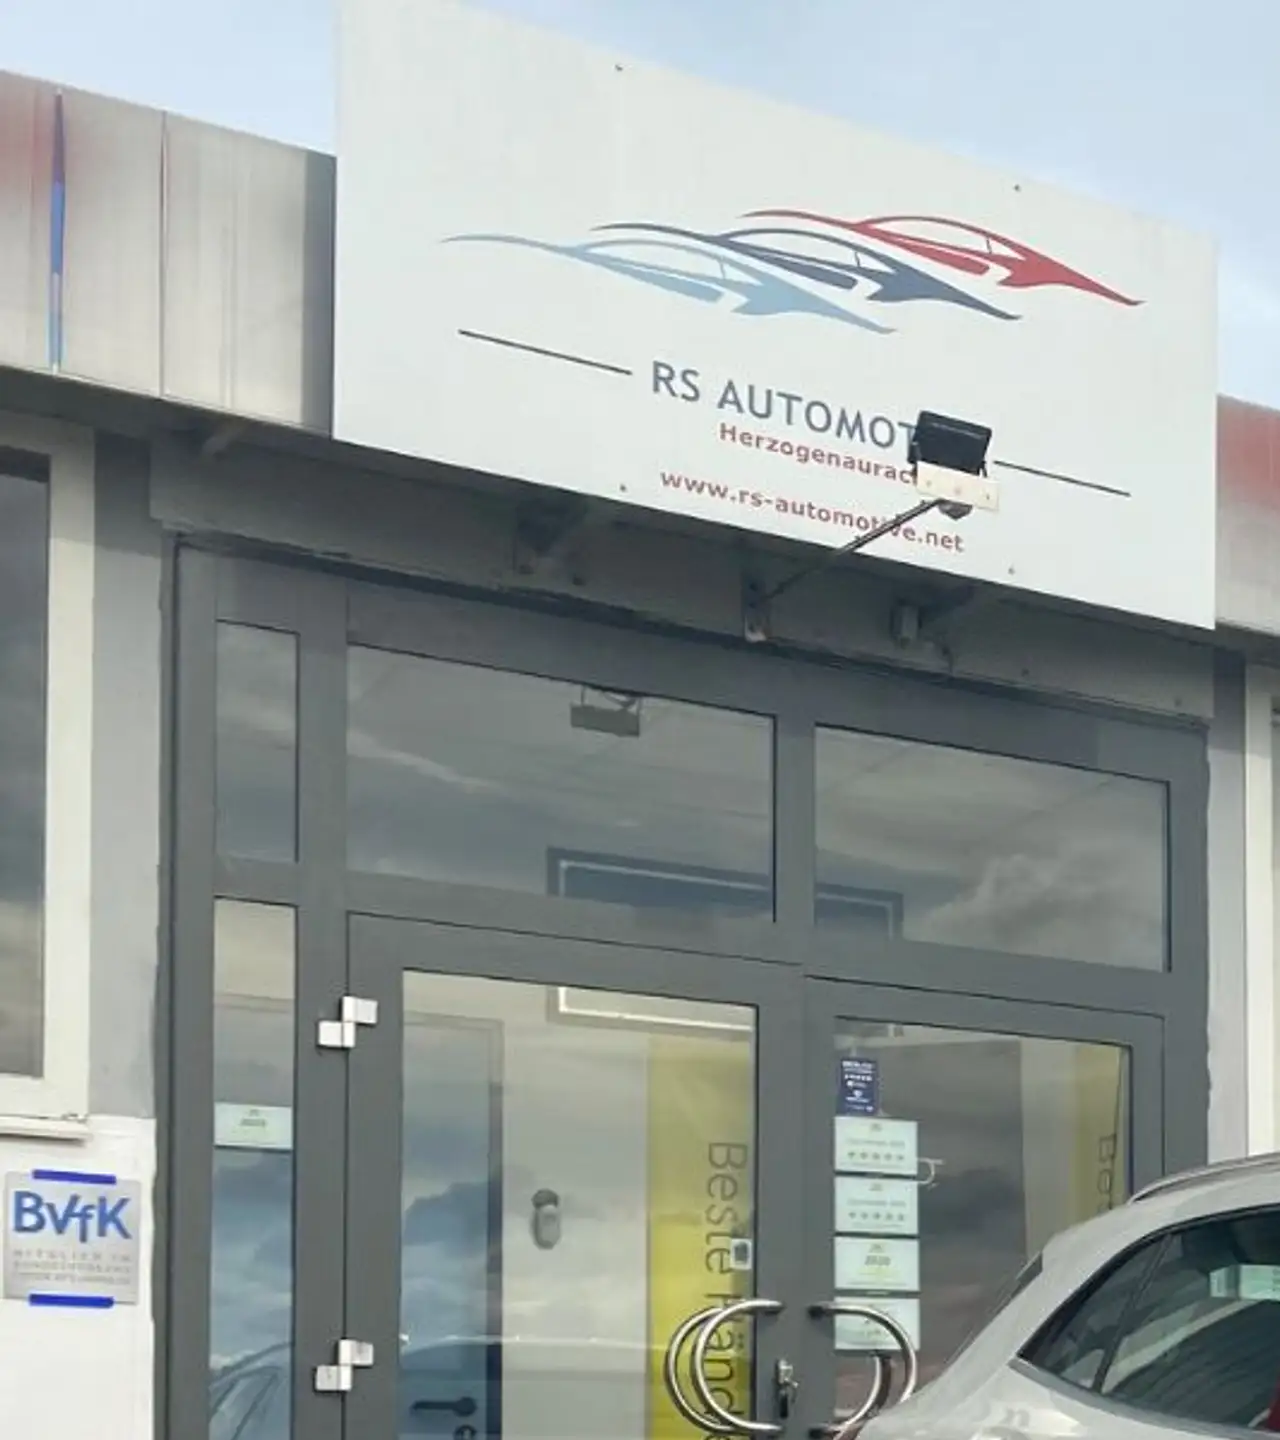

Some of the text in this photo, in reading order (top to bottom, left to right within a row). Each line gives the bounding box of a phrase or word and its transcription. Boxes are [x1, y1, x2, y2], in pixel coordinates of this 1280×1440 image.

[652, 360, 917, 450] RS AUTOMOT
[718, 422, 918, 486] Herzogenaurac
